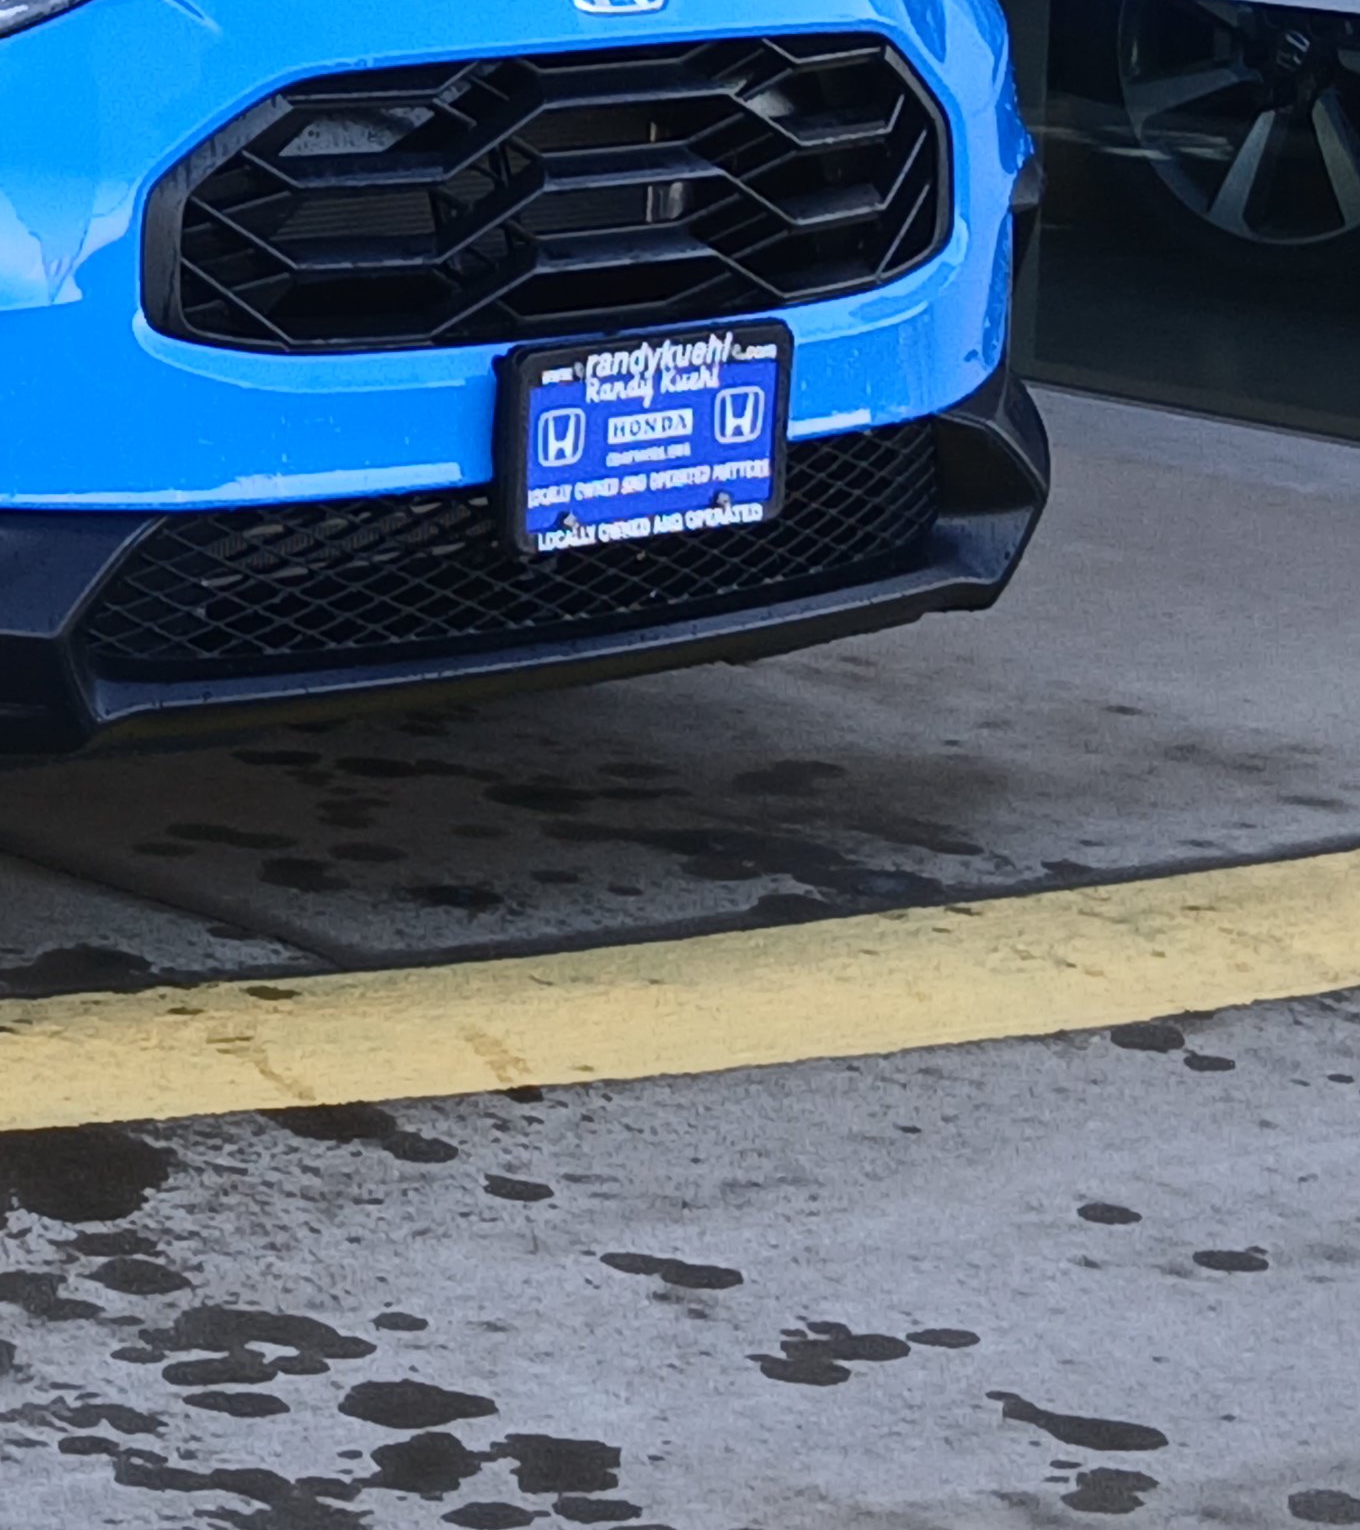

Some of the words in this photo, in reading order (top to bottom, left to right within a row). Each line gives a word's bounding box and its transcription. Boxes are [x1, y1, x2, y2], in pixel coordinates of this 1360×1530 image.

[585, 371, 654, 408] Randy
[661, 365, 720, 393] Kuehl
[612, 414, 688, 438] HONDA
[537, 522, 598, 551] LOCALLY
[598, 517, 650, 541] OWNED
[653, 513, 684, 535] AND
[685, 503, 763, 530] OPERATED
